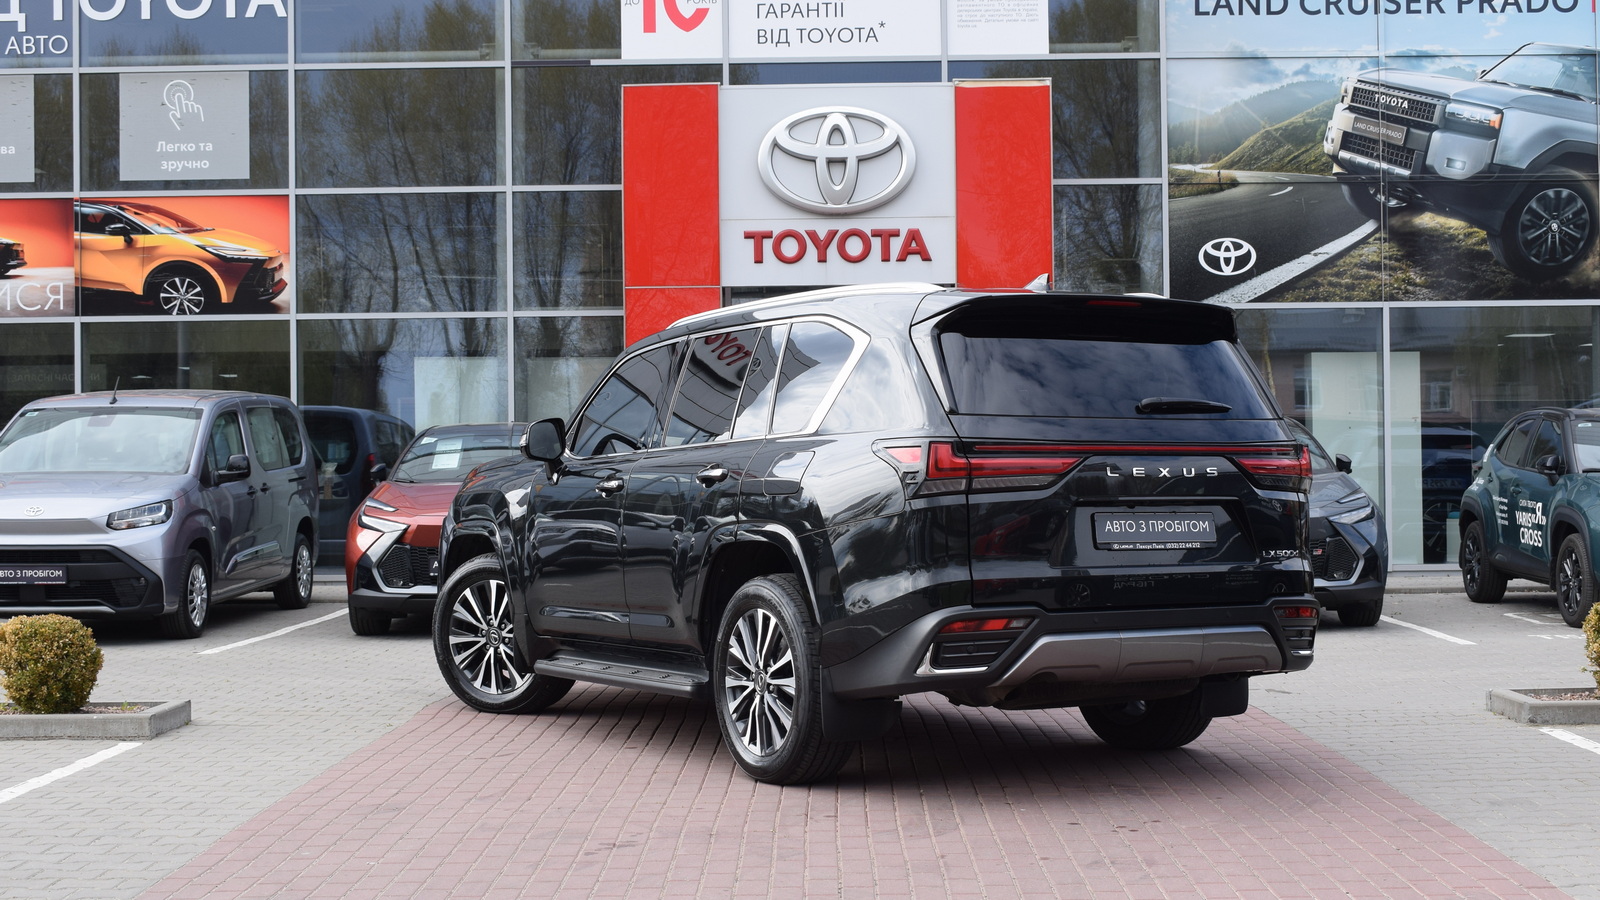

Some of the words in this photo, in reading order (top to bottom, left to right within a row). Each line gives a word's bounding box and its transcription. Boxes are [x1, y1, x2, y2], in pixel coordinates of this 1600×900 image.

[4, 34, 69, 55] АВТО
[757, 28, 791, 47] ВІД
[1374, 94, 1409, 109] TOYOTA
[1354, 121, 1367, 130] LAND
[1386, 128, 1403, 139] PRADO
[156, 141, 196, 153] Легко
[199, 142, 214, 152] та
[160, 159, 210, 172] зручно
[743, 228, 933, 265] TOYOTA
[1106, 466, 1219, 478] LEXUS
[1104, 520, 1136, 533] АВТО
[1149, 520, 1210, 533] ПРОБІГОМ
[1515, 510, 1532, 527] YARIS
[1519, 527, 1543, 548] CROSS
[0, 569, 15, 578] ВТО
[22, 569, 63, 578] ПРОБІГОМ
